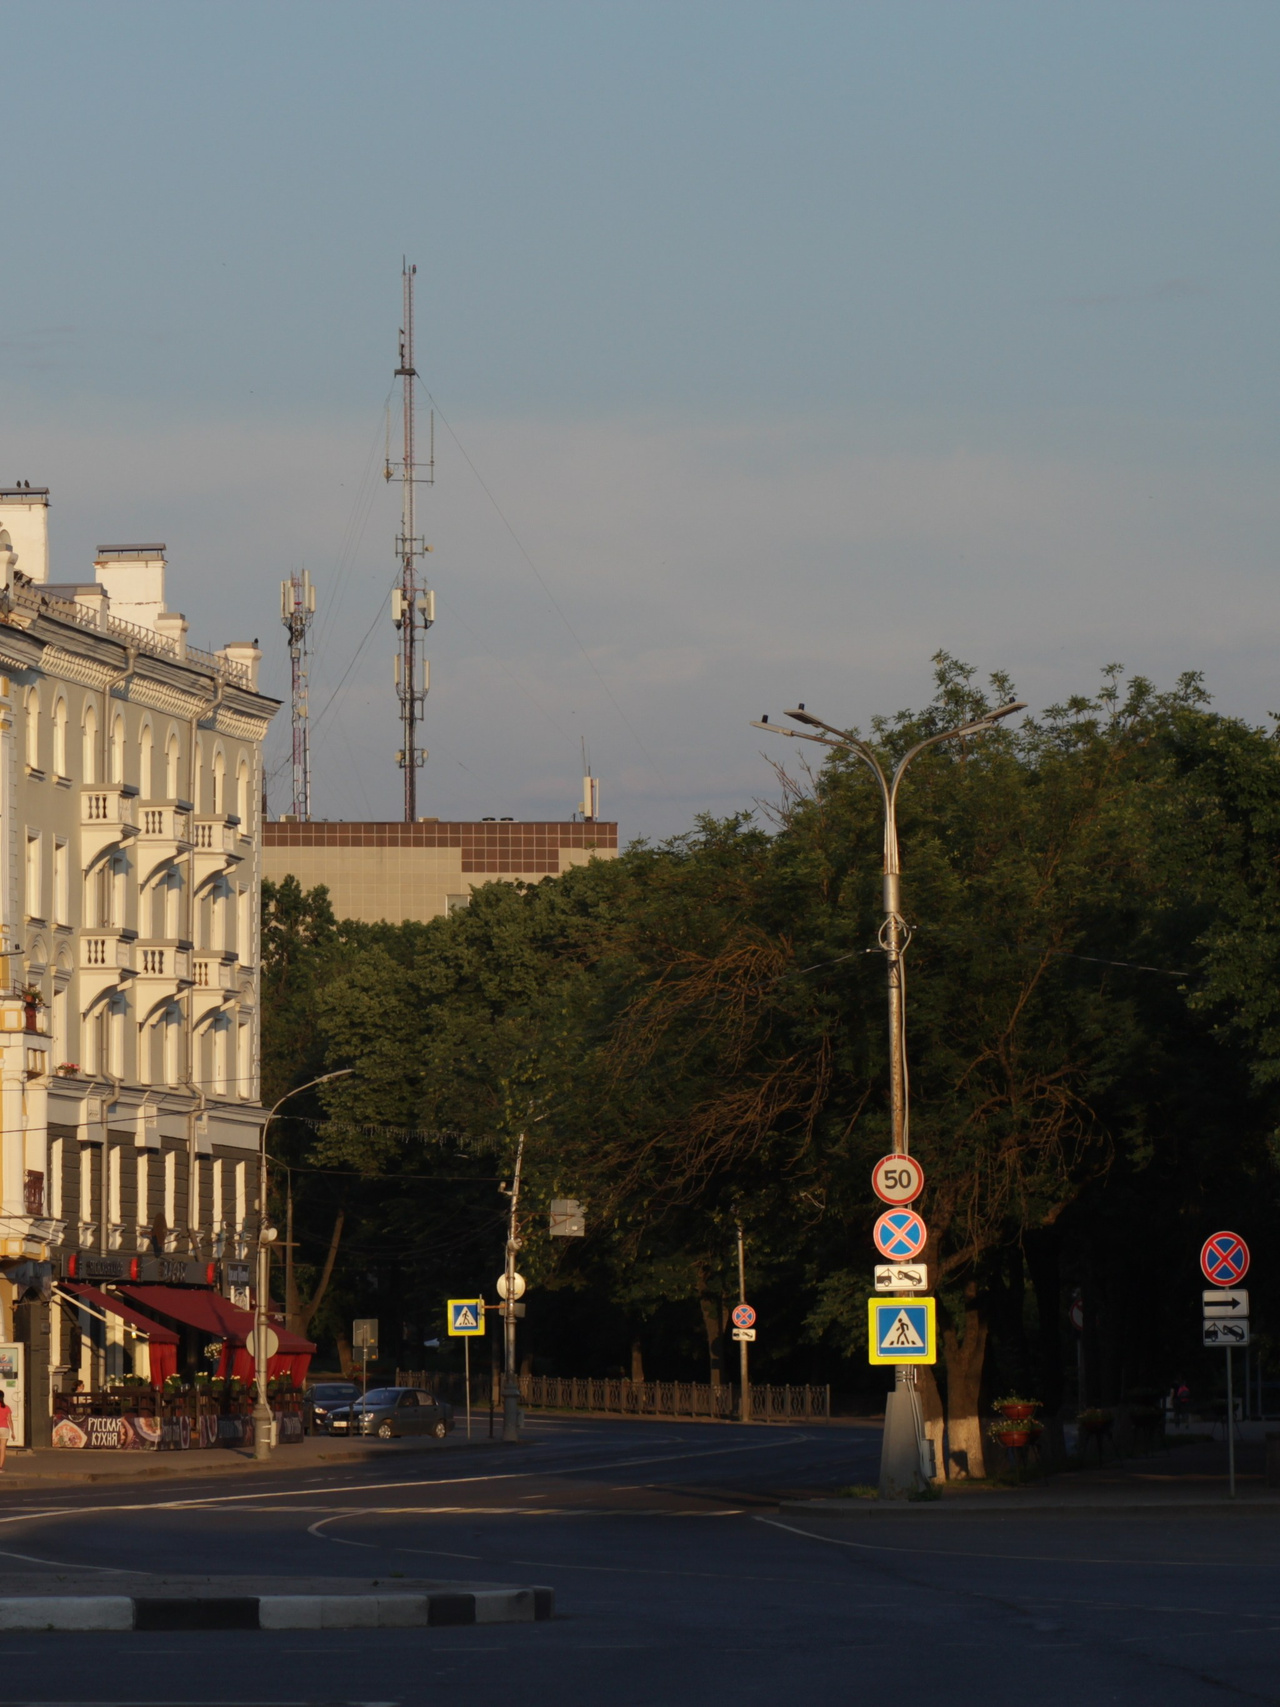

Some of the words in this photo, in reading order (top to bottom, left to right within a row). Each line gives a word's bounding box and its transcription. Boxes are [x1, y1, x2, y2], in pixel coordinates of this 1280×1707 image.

[884, 1169, 911, 1189] 50
[88, 1418, 121, 1431] РУССКАЯ
[91, 1433, 118, 1446] КУХНЯ
